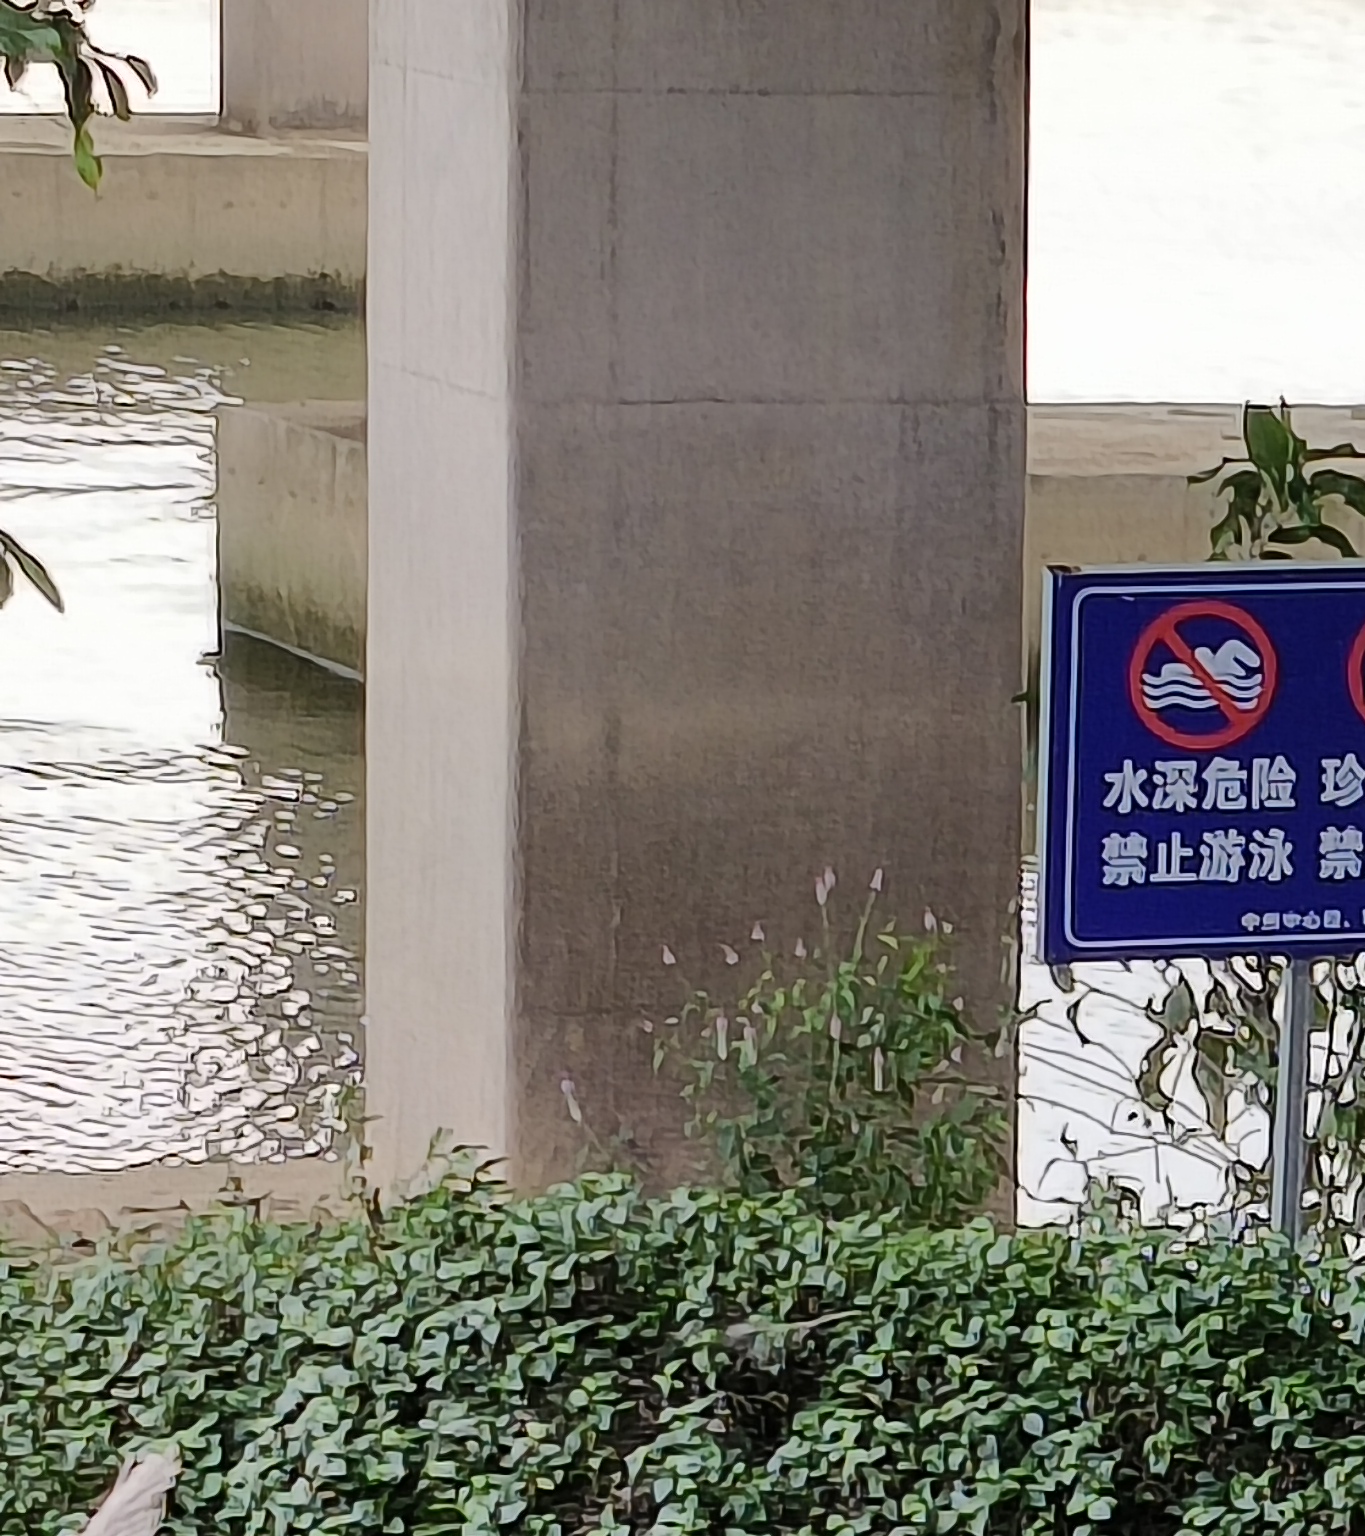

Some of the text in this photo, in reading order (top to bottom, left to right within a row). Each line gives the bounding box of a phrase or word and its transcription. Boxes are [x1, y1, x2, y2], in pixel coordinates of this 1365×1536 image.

[1103, 755, 1296, 813] 水深危险
[1102, 829, 1294, 887] 禁止游泳
